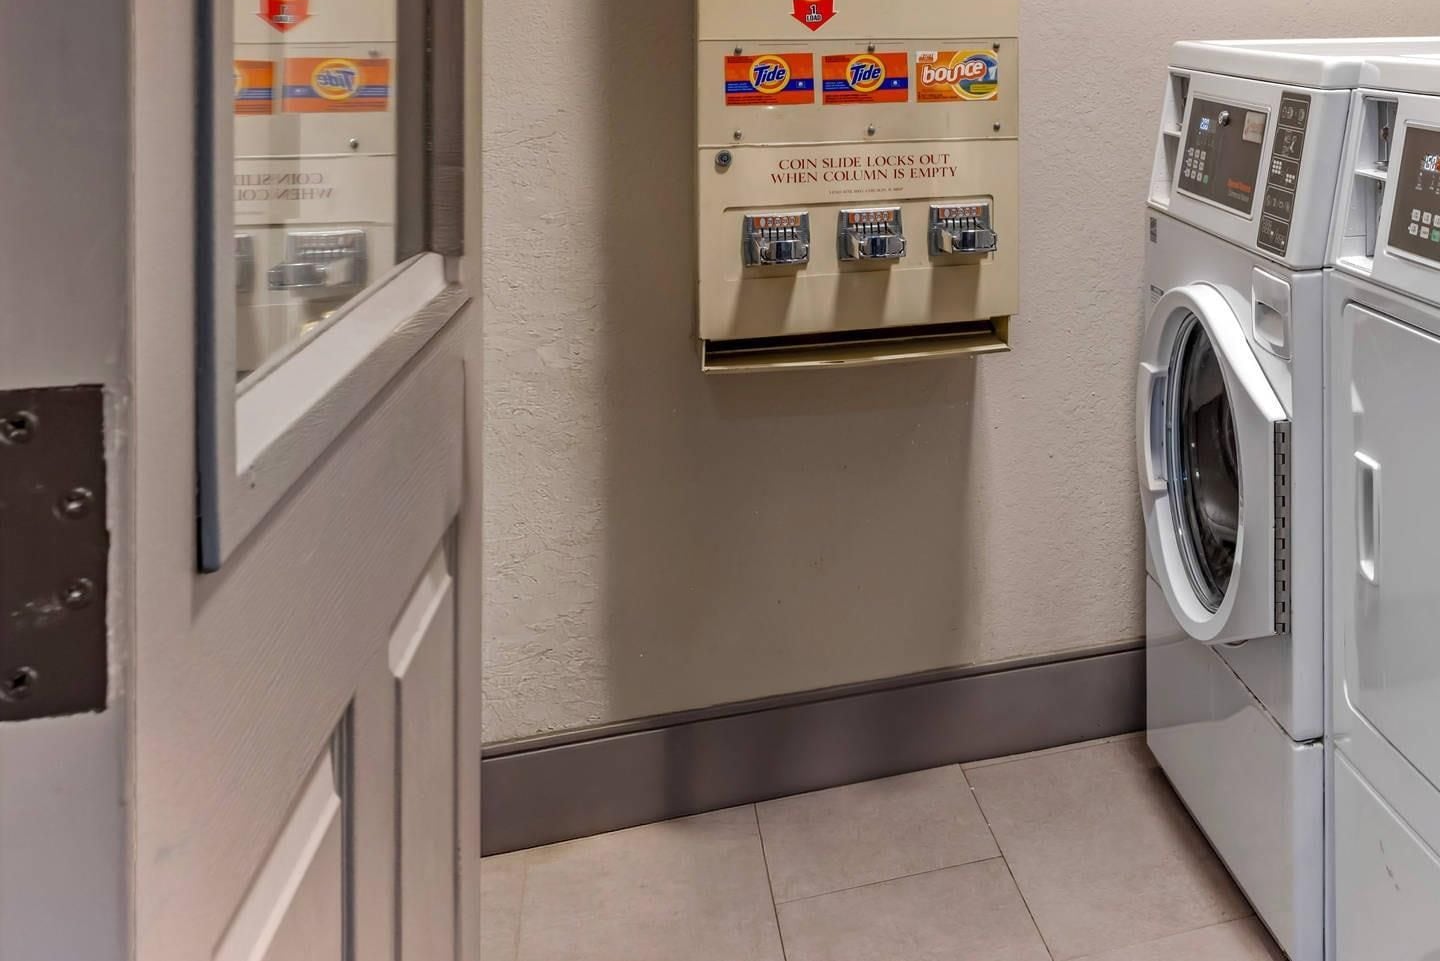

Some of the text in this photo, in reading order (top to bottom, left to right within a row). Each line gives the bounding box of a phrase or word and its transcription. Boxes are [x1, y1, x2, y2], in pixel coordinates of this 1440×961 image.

[806, 14, 822, 22] LOAD
[809, 4, 817, 15] 1
[753, 63, 787, 88] Tide
[850, 63, 881, 86] Tide
[922, 61, 985, 84] bounce
[778, 153, 950, 171] COIN SLIDE LOCKS OUT
[770, 166, 958, 184] WHEN COLUMN IS EMPTY
